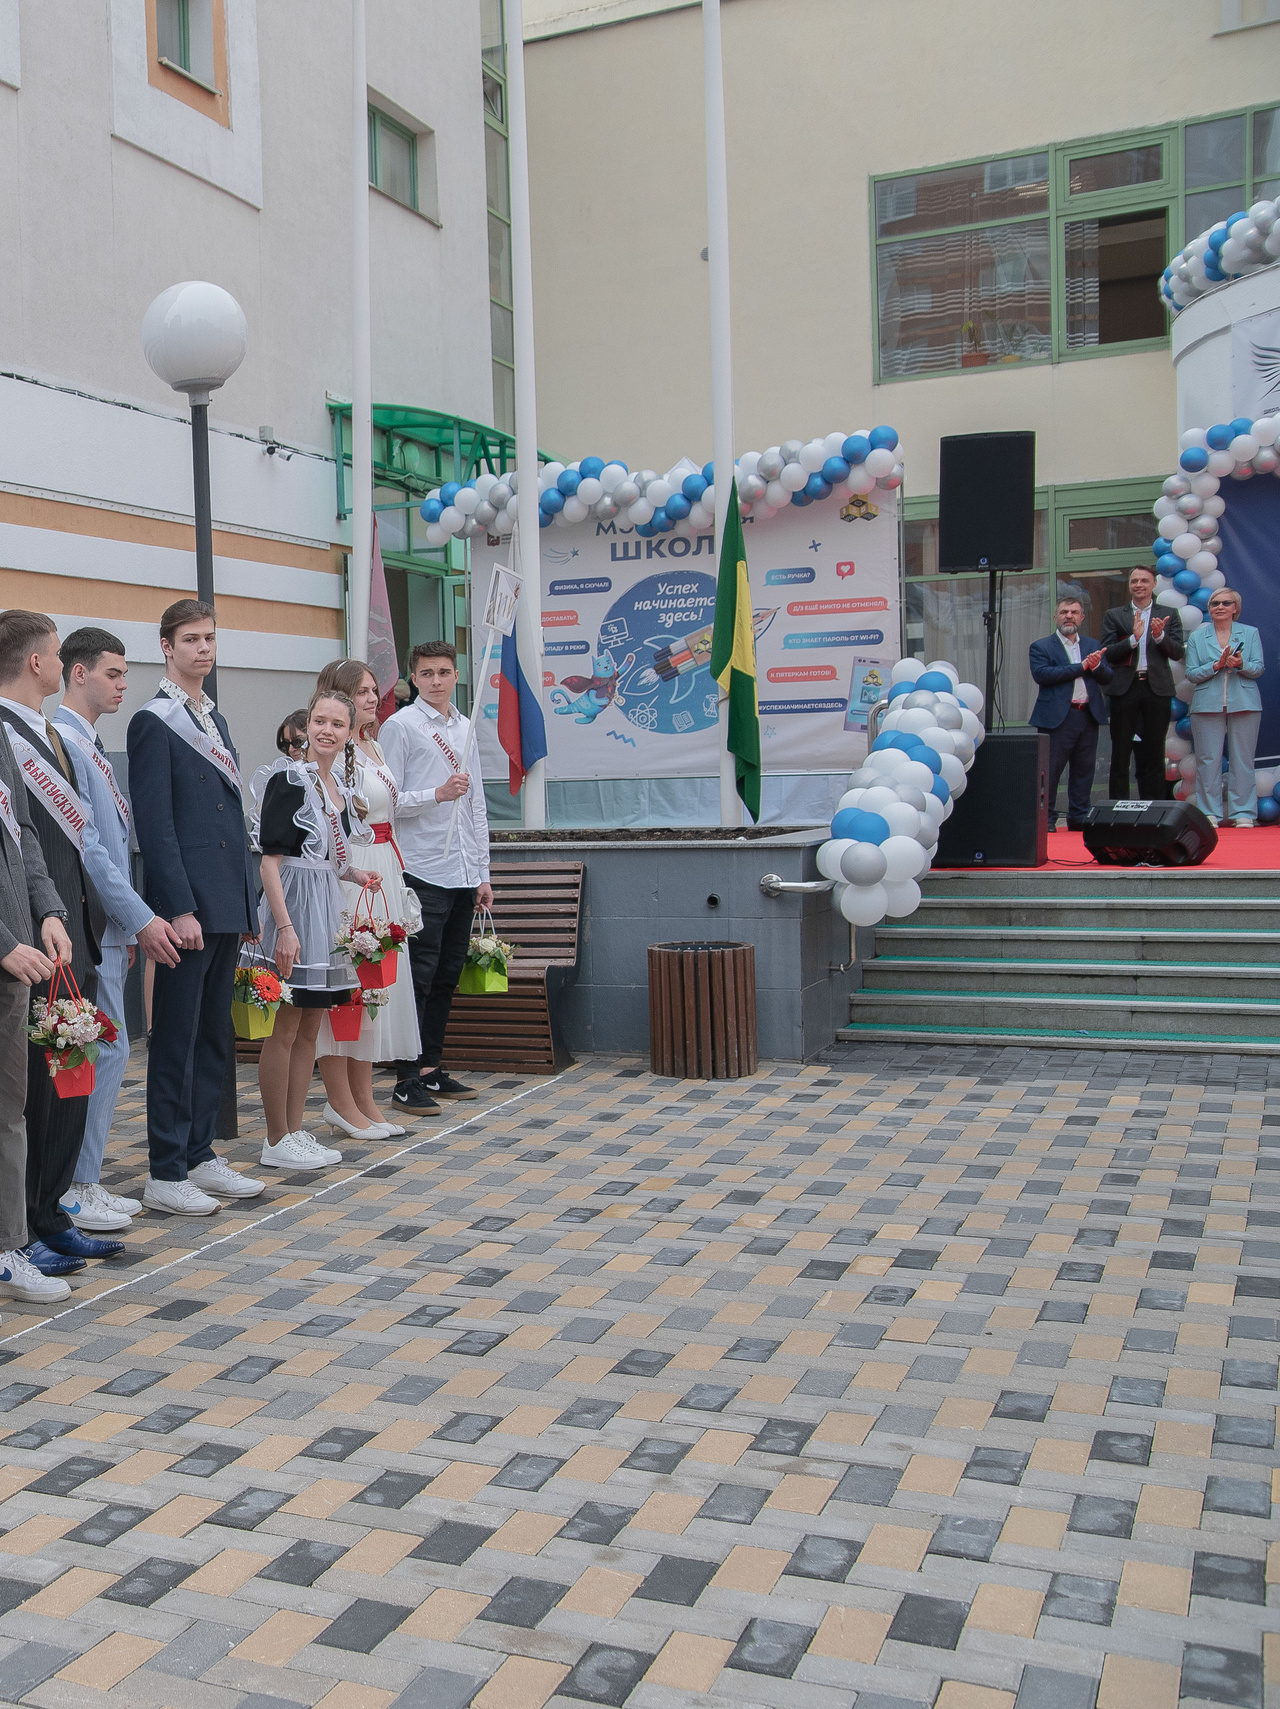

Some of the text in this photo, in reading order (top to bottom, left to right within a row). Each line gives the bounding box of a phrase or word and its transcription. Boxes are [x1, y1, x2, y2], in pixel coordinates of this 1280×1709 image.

[610, 535, 715, 562] ШКОЛ
[656, 582, 700, 596] Успех
[634, 596, 716, 611] начинаетс
[657, 608, 704, 628] здесь!
